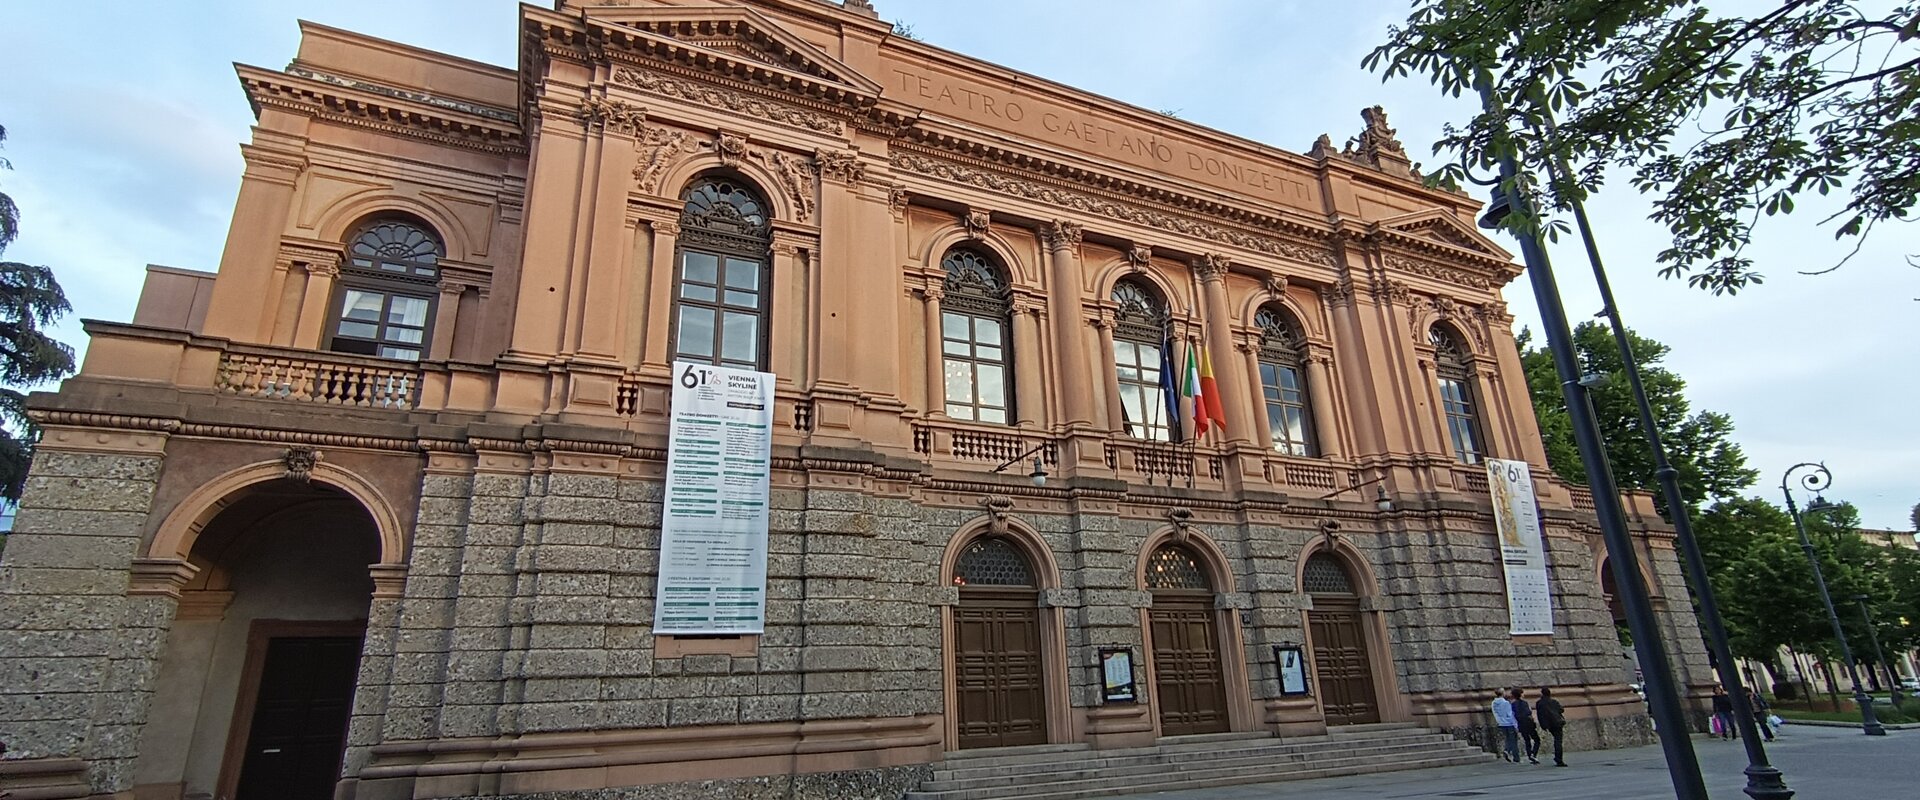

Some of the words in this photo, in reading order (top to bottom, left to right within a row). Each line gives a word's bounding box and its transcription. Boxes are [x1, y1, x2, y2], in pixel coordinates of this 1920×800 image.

[893, 68, 1025, 123] TEATRO
[1042, 112, 1173, 164] GAETANO
[1187, 151, 1313, 202] DONIZETTI
[728, 375, 757, 383] VIENNA
[728, 382, 757, 390] SKYLINE
